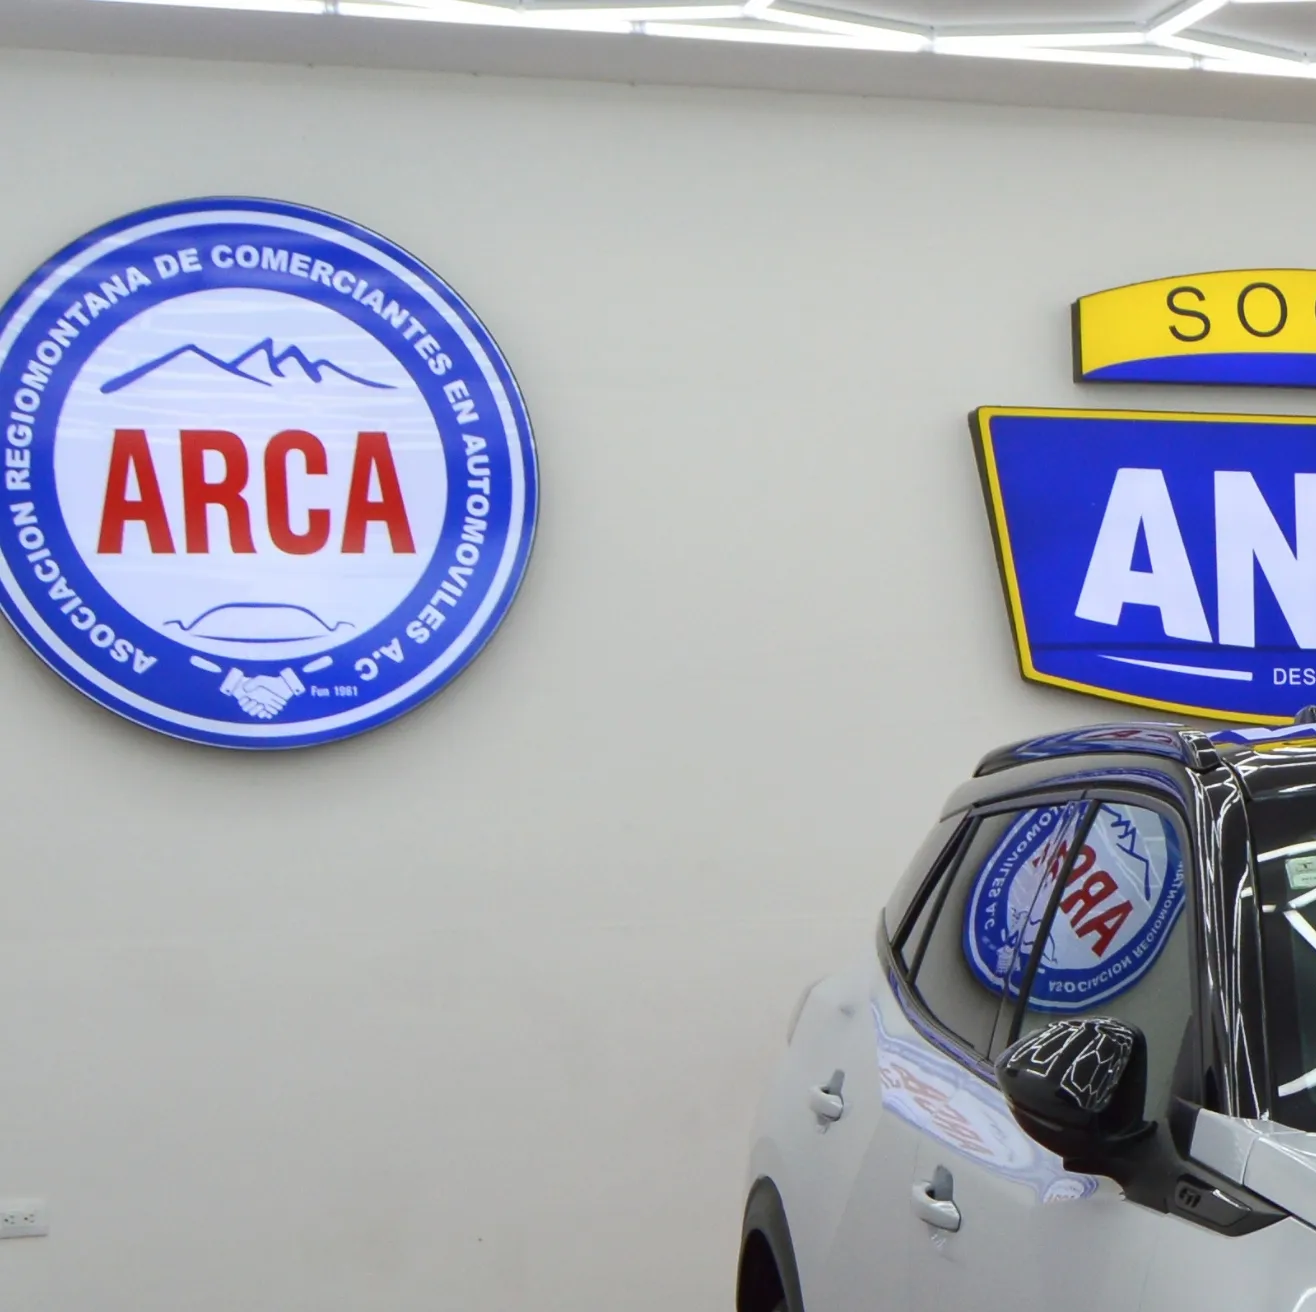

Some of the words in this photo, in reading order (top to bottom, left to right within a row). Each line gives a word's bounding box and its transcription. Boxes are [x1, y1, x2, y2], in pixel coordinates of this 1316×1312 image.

[153, 247, 203, 279] DE
[210, 244, 453, 376] COMERCIANTES
[5, 266, 152, 491] REGIOMONTANA
[443, 379, 480, 425] EN
[96, 428, 416, 556] ARCA
[405, 433, 491, 645] AUTOMOVILES
[9, 501, 158, 674] ASOCIACION
